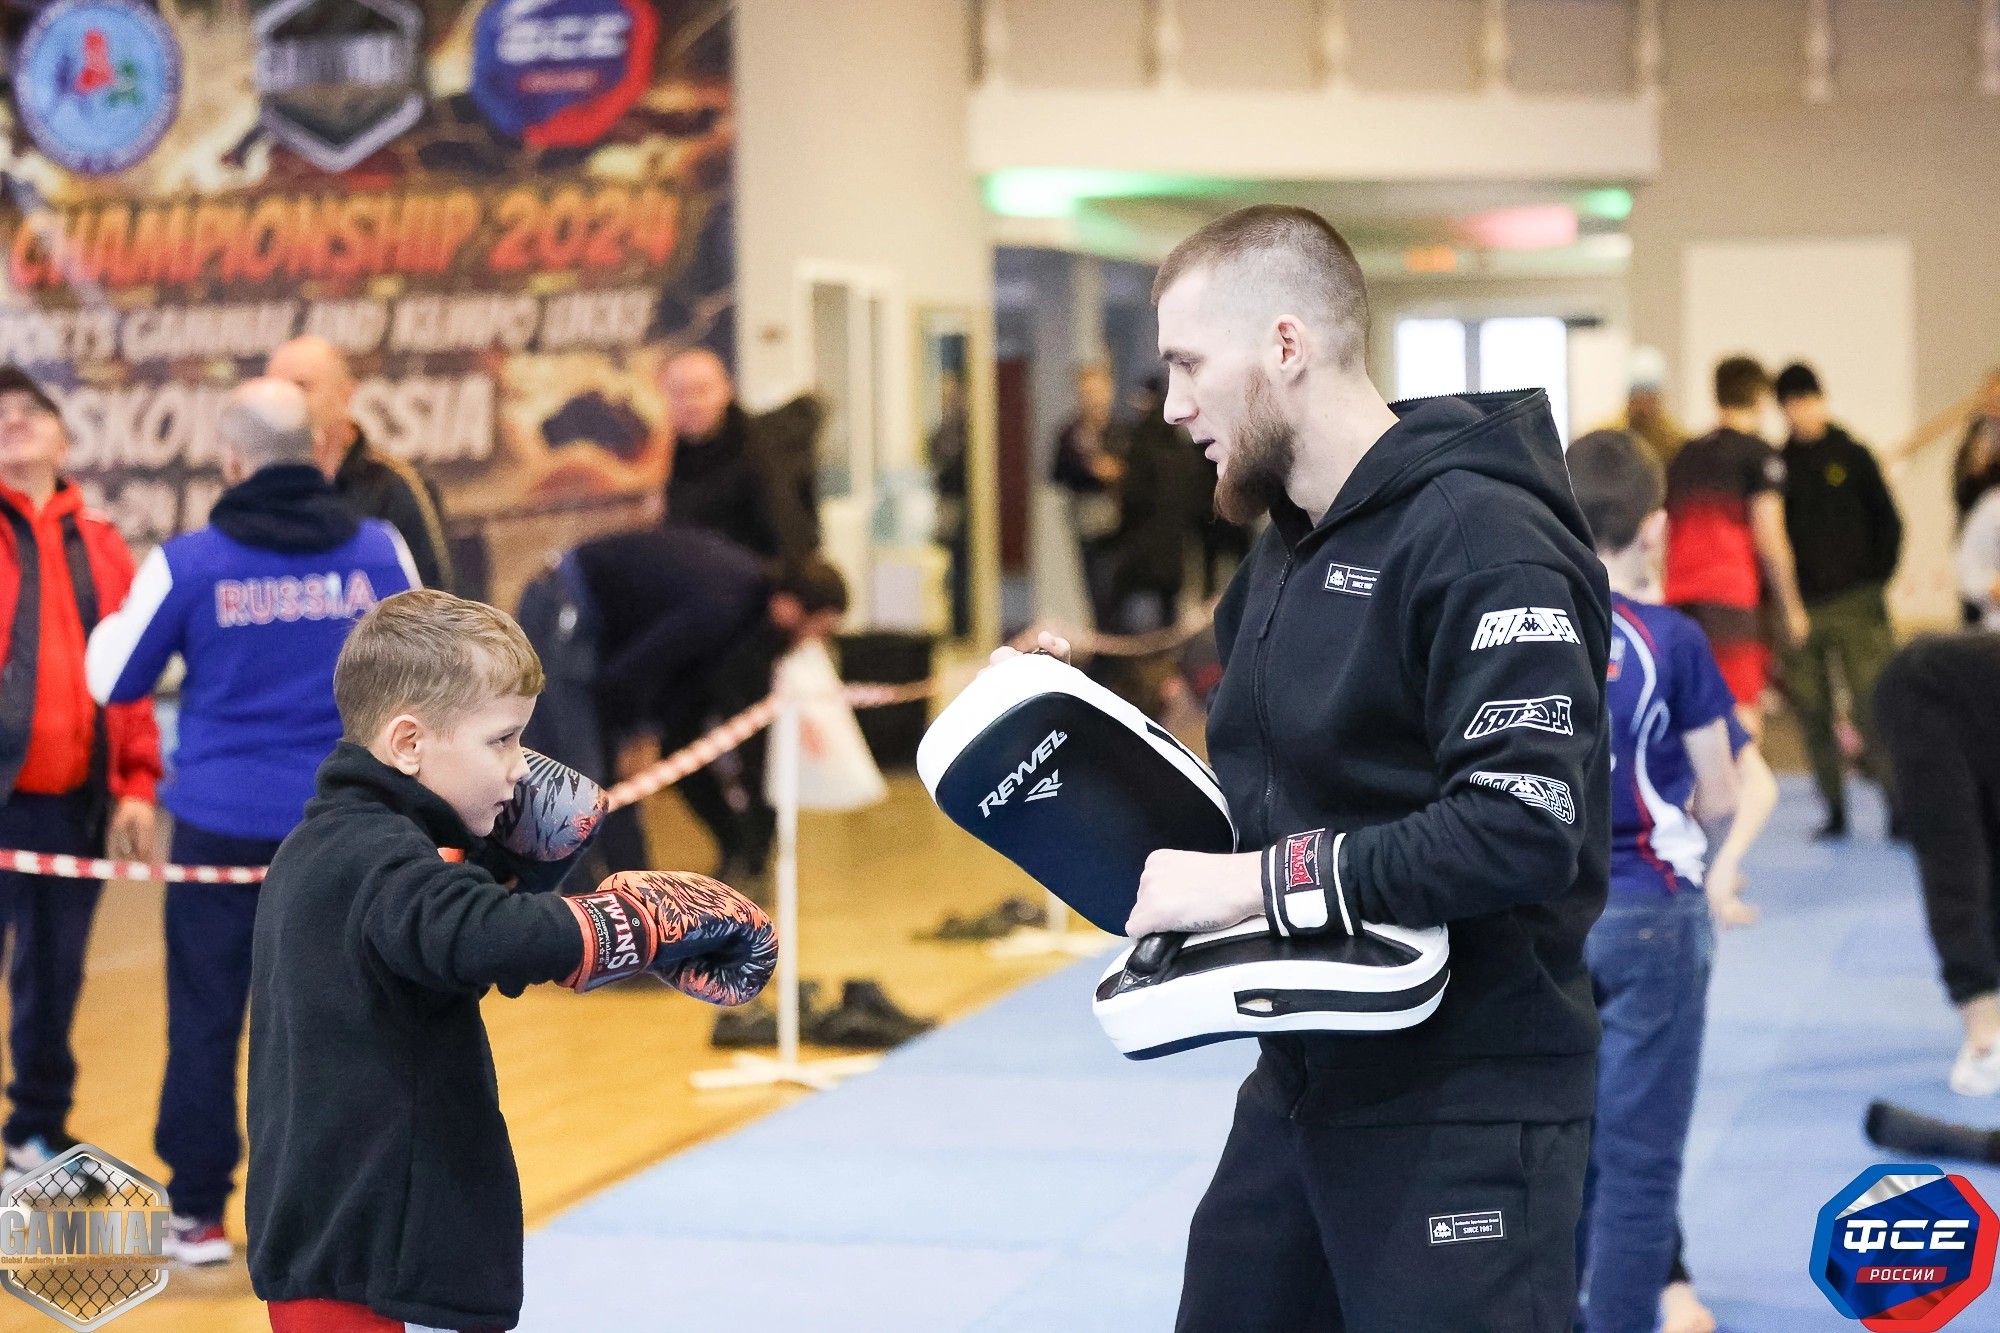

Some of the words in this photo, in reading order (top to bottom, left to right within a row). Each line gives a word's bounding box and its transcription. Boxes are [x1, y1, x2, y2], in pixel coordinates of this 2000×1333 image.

[488, 186, 679, 272] 2024
[213, 570, 380, 628] RUSSIA
[586, 893, 640, 970] TWINS
[591, 914, 605, 948] SPECIAL
[1463, 1226, 1479, 1234] SINCE
